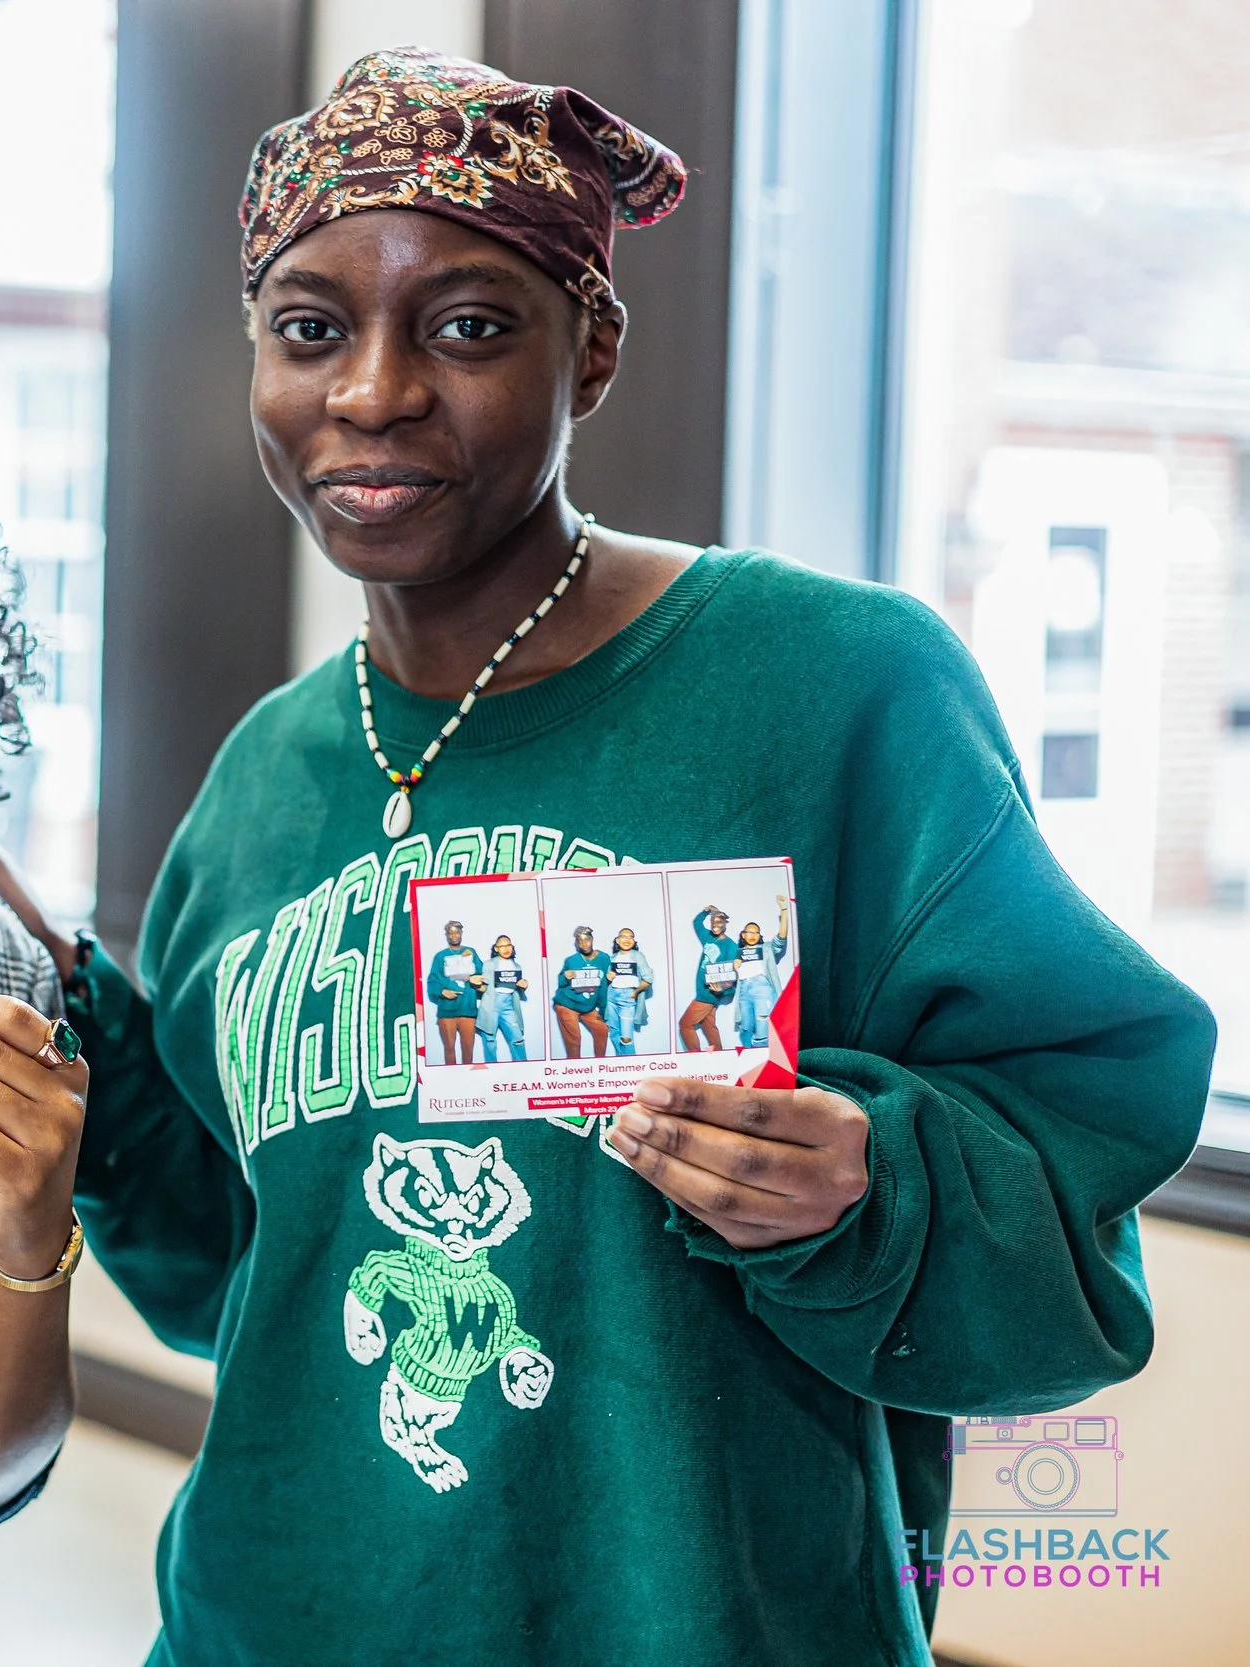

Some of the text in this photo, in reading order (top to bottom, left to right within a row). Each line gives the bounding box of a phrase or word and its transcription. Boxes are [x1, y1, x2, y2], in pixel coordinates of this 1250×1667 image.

[544, 1060, 678, 1076] Dr. Jewel Plummer Cobb
[493, 1082, 545, 1093] S.T.E.A.M.
[547, 1078, 595, 1091] Women's
